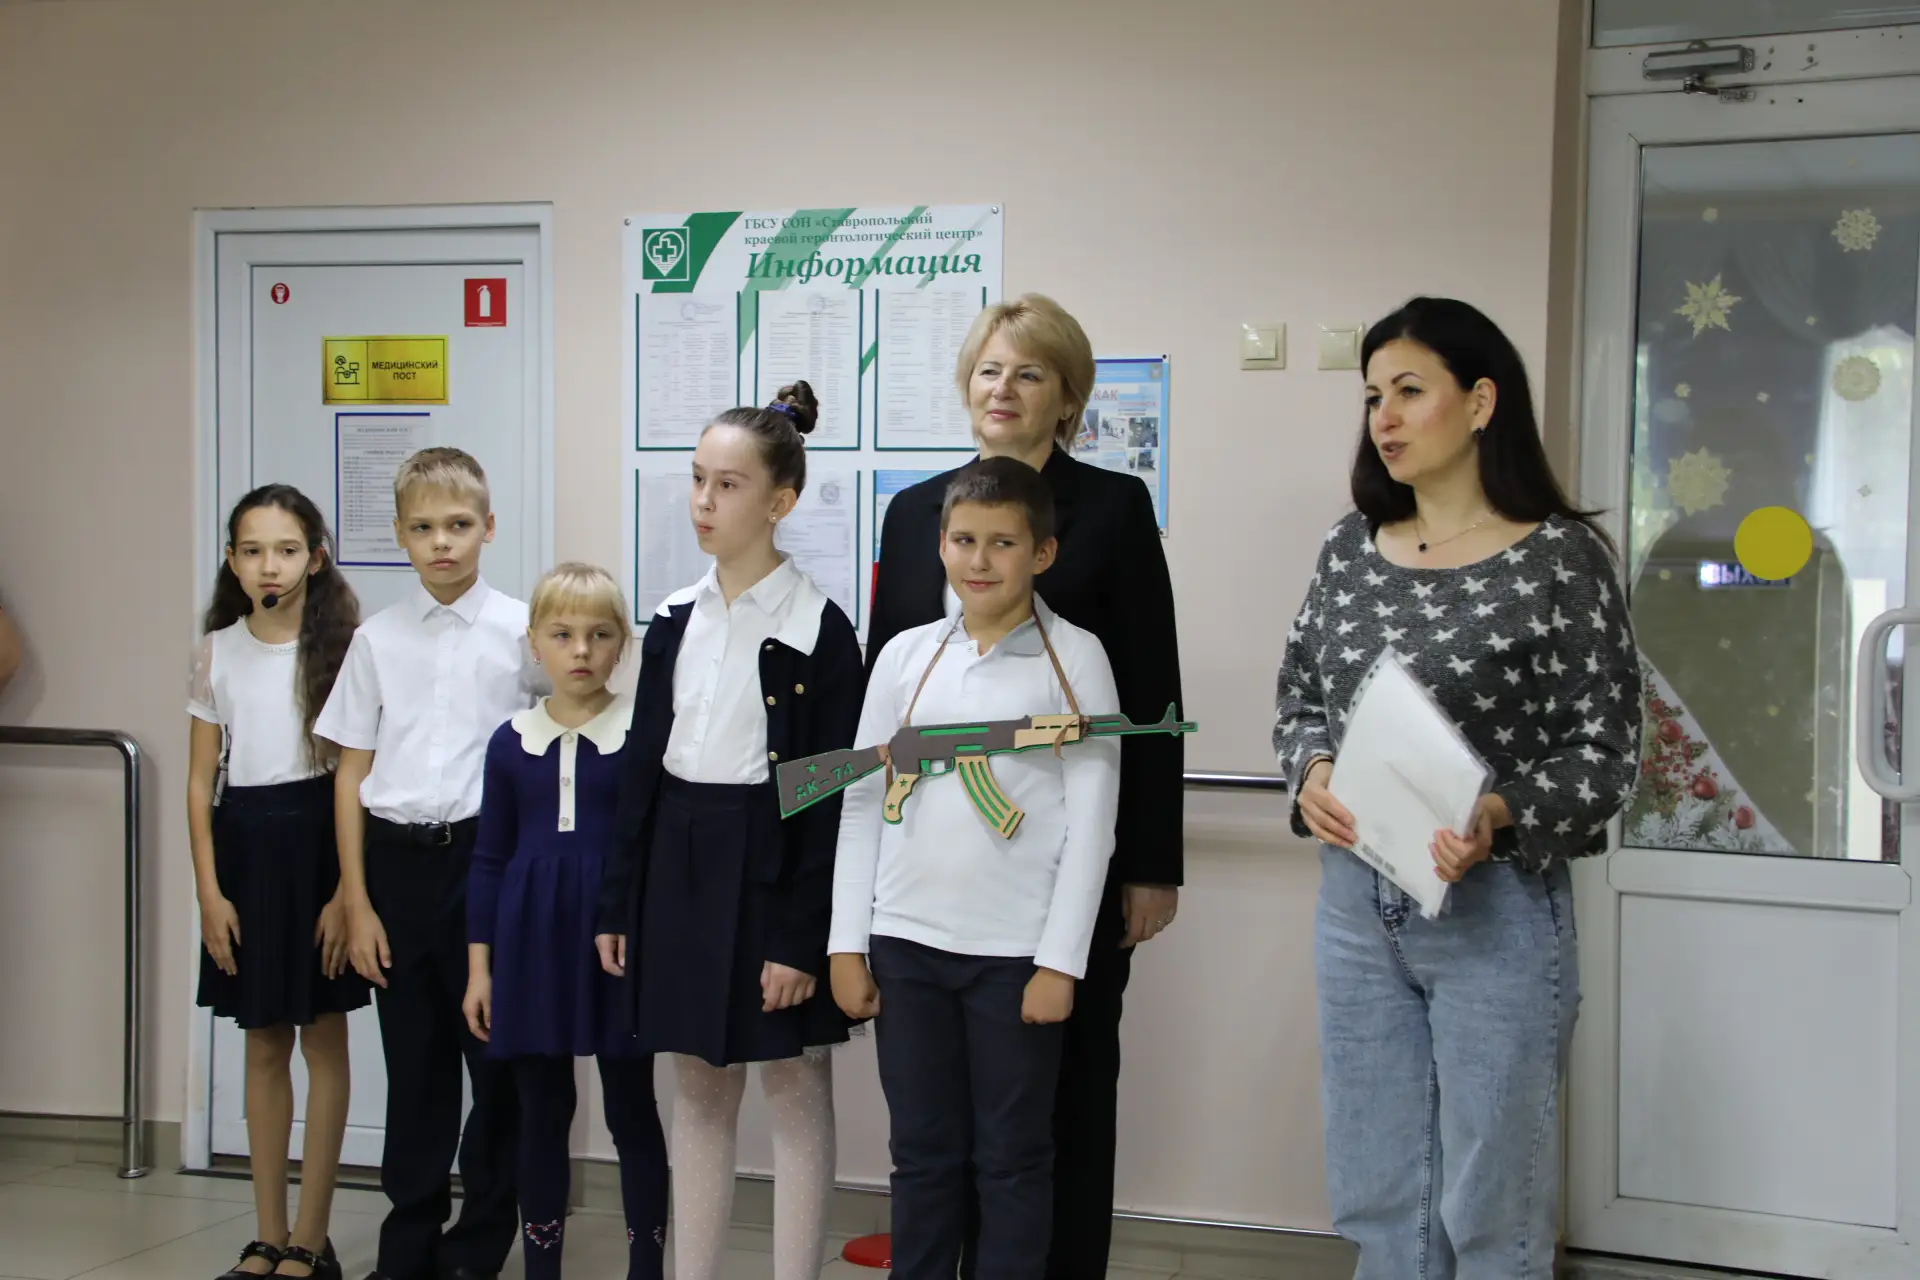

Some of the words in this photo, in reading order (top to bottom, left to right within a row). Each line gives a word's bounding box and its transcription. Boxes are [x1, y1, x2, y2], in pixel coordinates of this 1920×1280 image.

[744, 218, 778, 230] ГБСУ
[782, 216, 811, 229] СОН
[816, 212, 933, 230] «Ставропольский
[744, 232, 798, 247] краевой
[801, 228, 932, 247] геронтологический
[936, 229, 983, 242] центр»
[744, 250, 983, 285] Информация
[371, 360, 439, 371] МЕДИЦИНСКИЙ
[393, 371, 417, 381] ПОСТ
